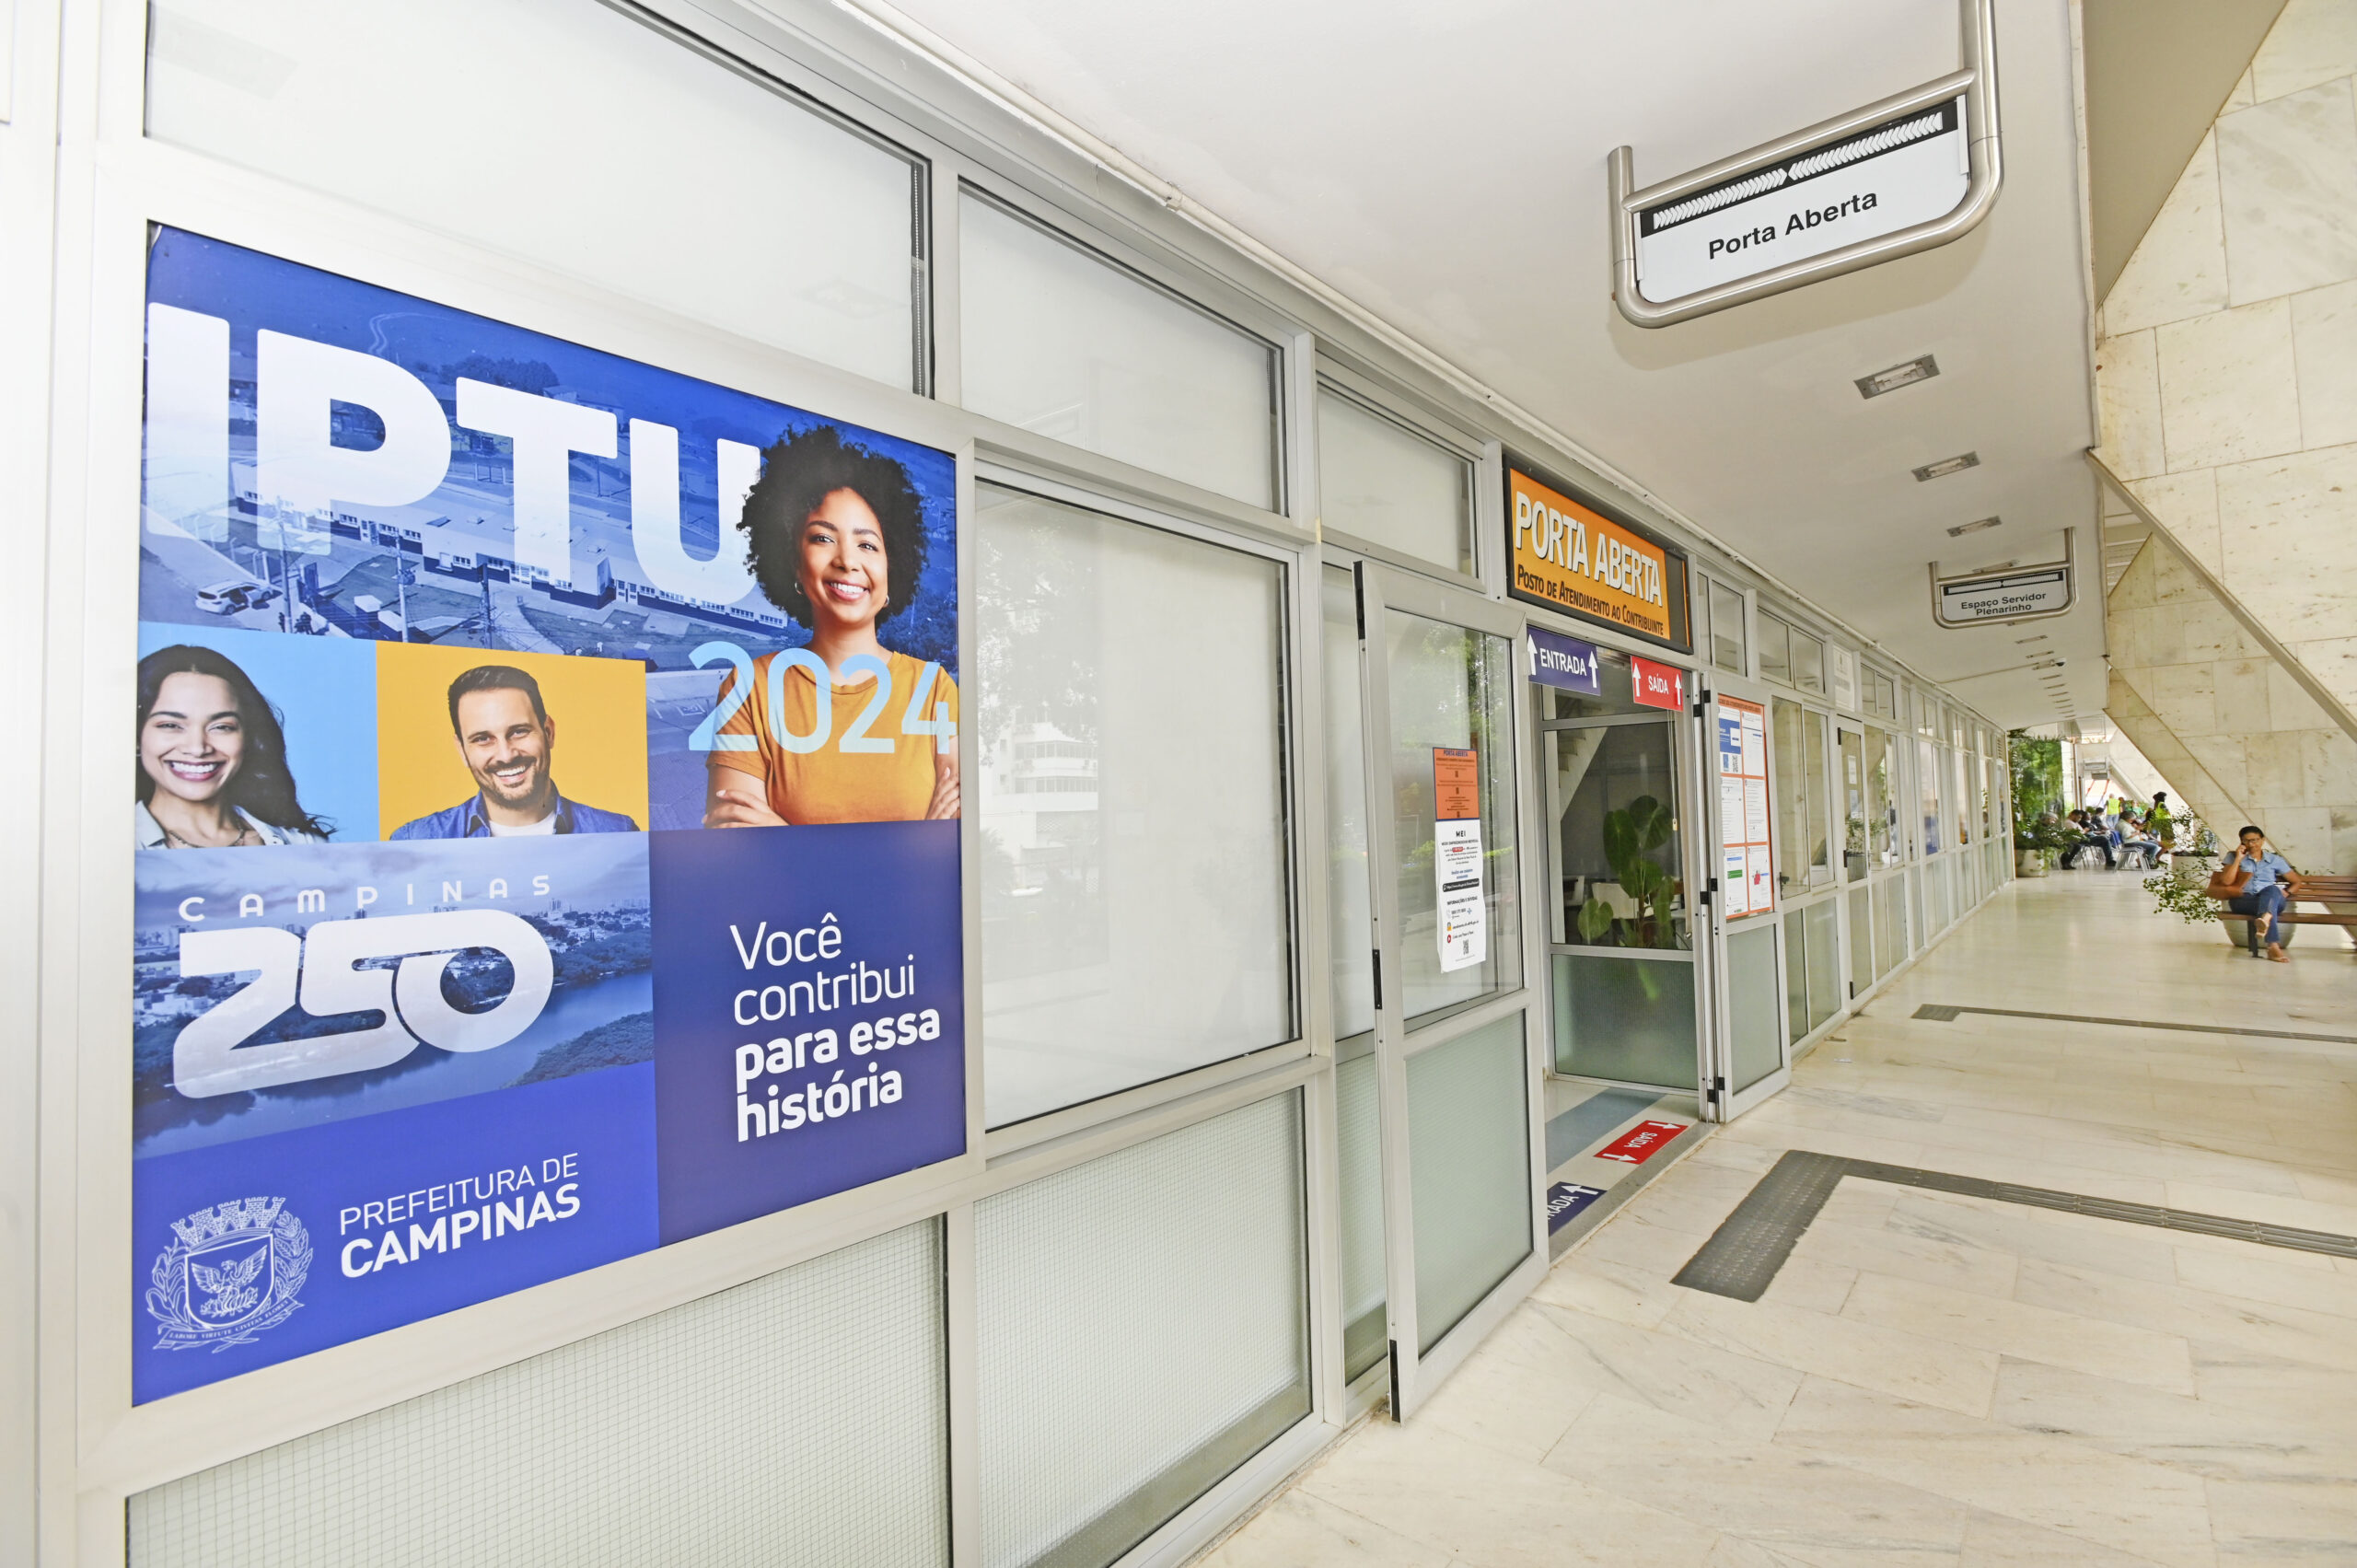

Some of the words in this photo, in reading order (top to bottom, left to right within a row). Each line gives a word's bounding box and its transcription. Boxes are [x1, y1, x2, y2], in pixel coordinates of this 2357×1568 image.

[1709, 222, 1776, 260] Porta
[1785, 192, 1878, 236] Aberta
[146, 302, 761, 606] IPTU
[1515, 491, 1590, 577] PORTA
[1594, 532, 1663, 608] ABERTA
[1517, 563, 1544, 594] POSTO
[1559, 581, 1610, 617] ATENDIMENTO
[1961, 598, 1999, 610] Espaço
[2002, 592, 2047, 605] Servidor
[1976, 603, 2032, 616] Plenarinho
[688, 640, 958, 754] 2024
[1540, 647, 1586, 677] ENTRADA
[1648, 673, 1669, 695] SAÍDA
[178, 874, 551, 923] CAMPINAS
[729, 912, 842, 970] Você
[172, 908, 554, 1099] 250
[734, 953, 915, 1027] contribui
[736, 1028, 839, 1094] para
[849, 1008, 941, 1056] essa
[737, 1061, 903, 1143] história
[1623, 1132, 1658, 1148] SAÍDA
[340, 1164, 534, 1237] PREFEITURA
[541, 1152, 579, 1180] DE
[341, 1182, 582, 1279] CAMPINAS
